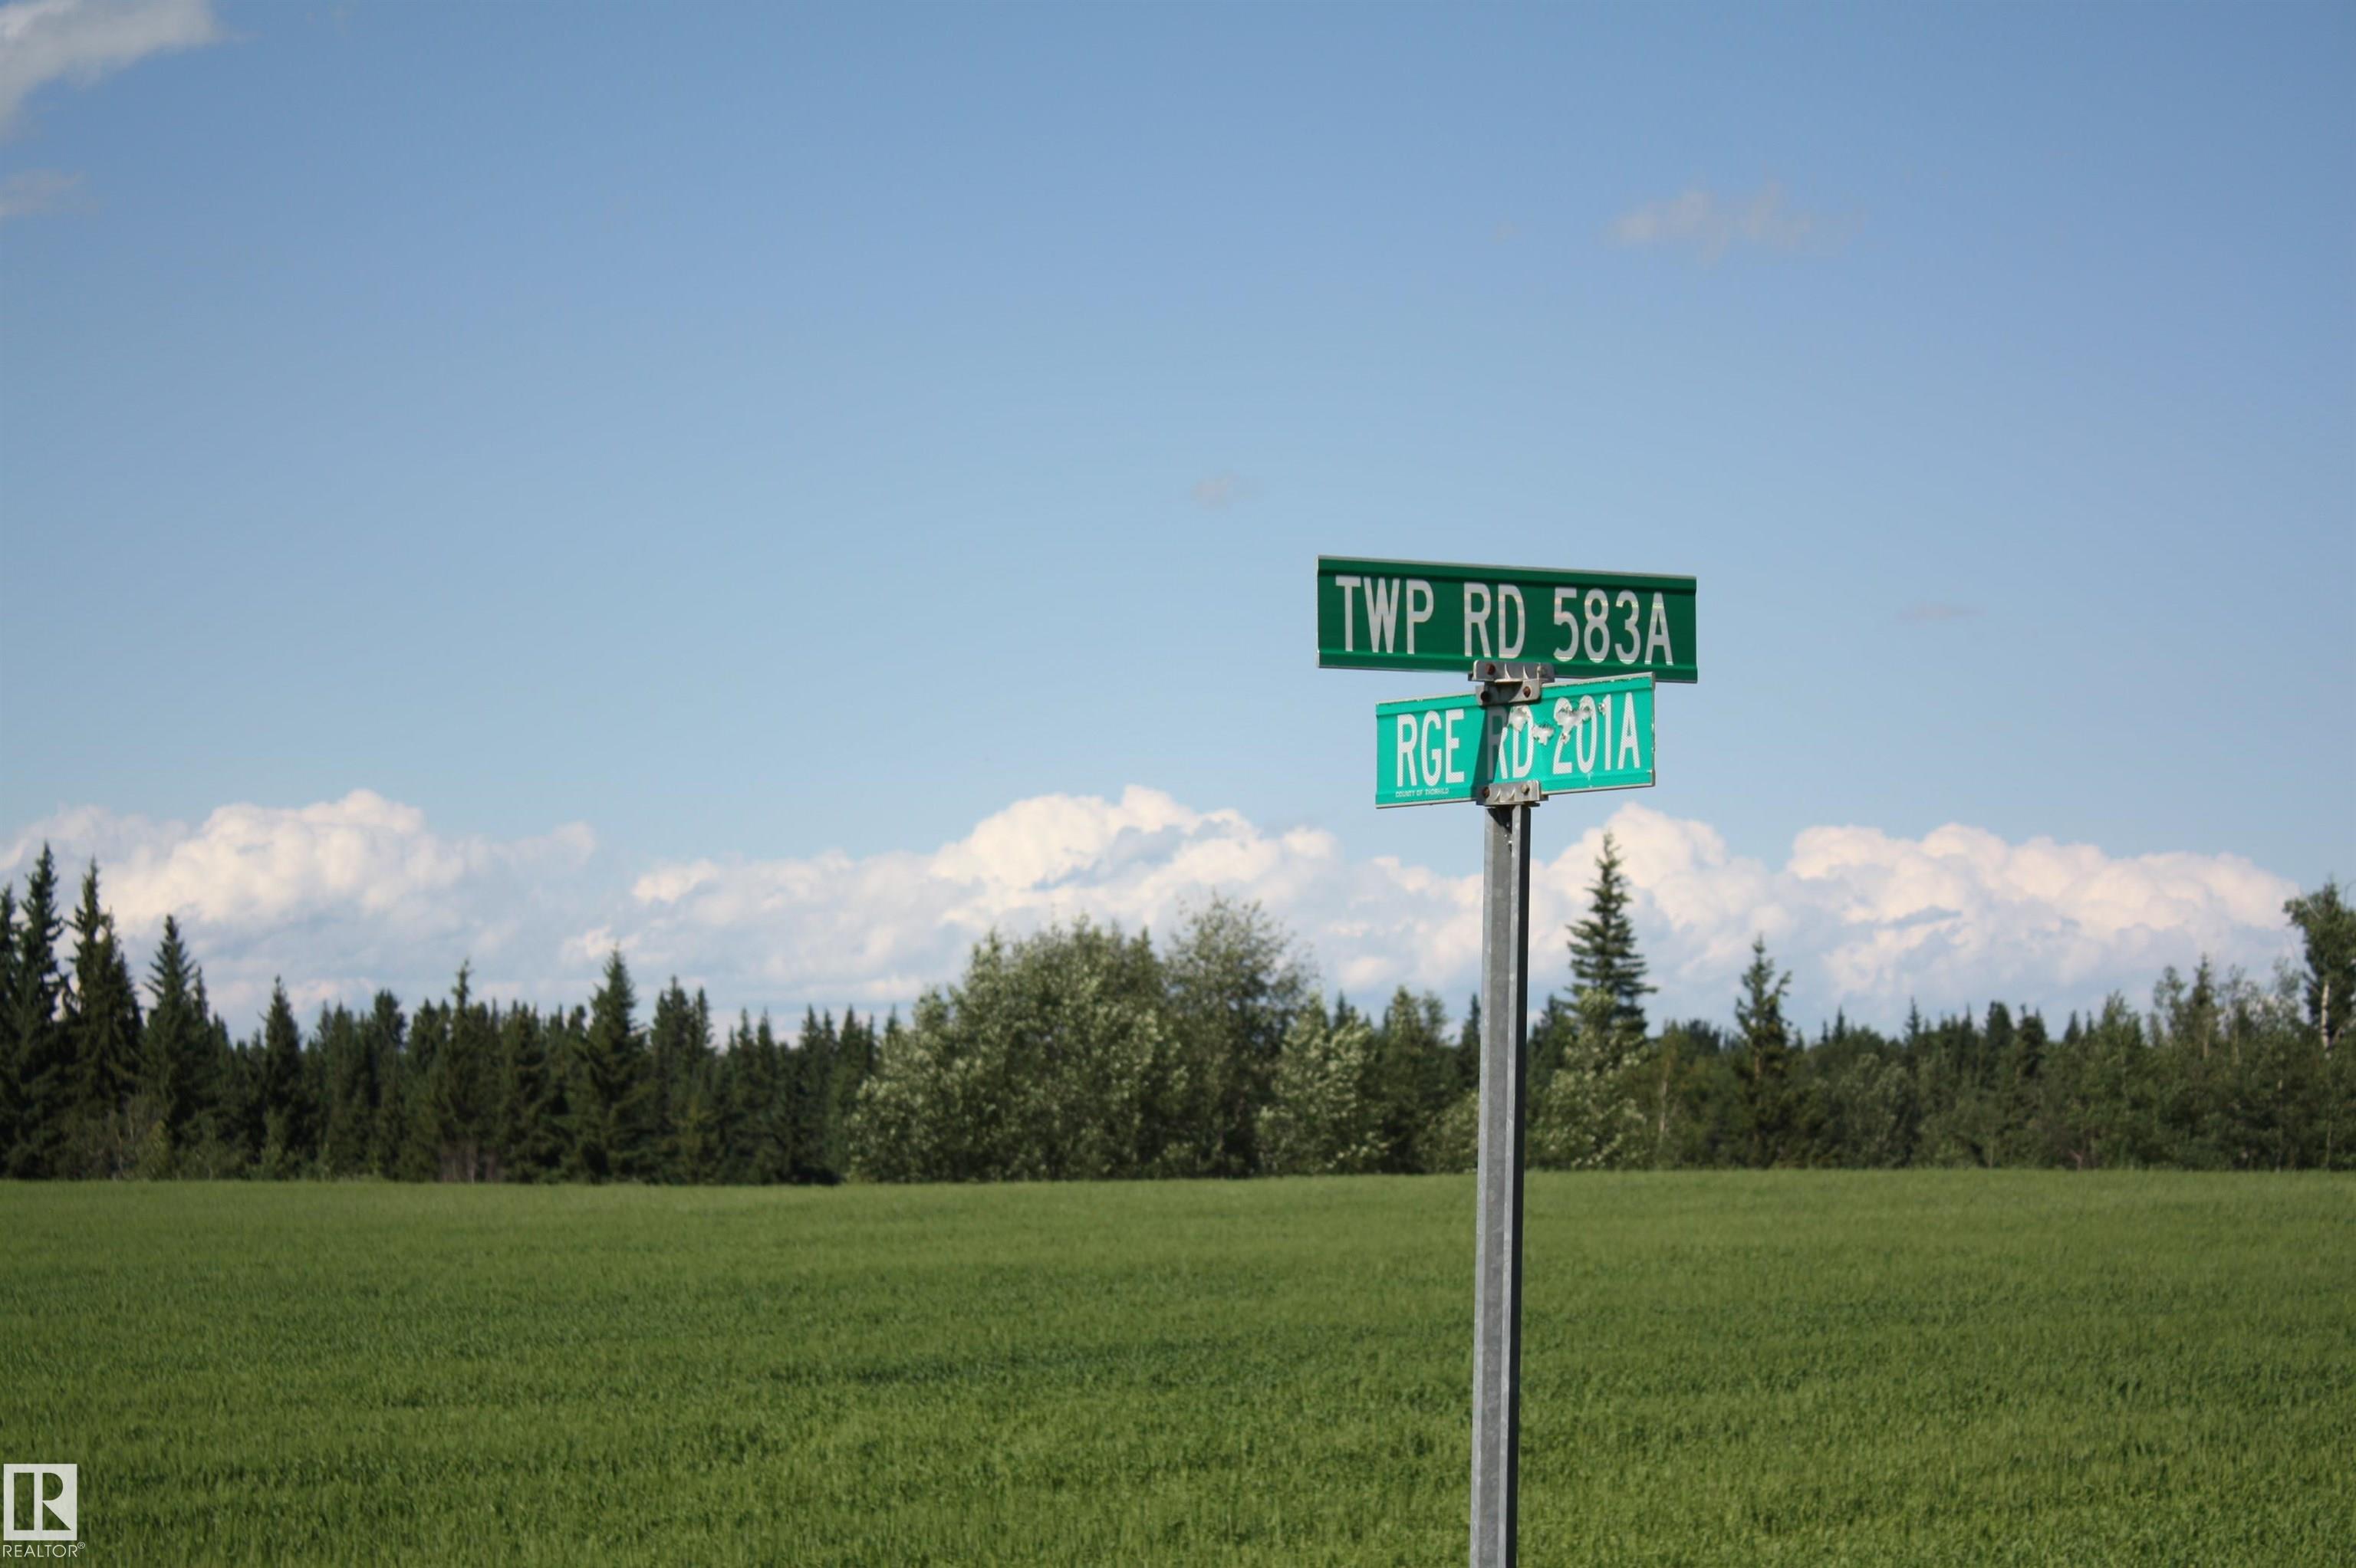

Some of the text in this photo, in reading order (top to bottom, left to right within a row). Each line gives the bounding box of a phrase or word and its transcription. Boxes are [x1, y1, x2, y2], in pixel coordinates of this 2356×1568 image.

[1335, 575, 1674, 666] TWP RD 583A
[1397, 692, 1640, 787] RGE RD 201A
